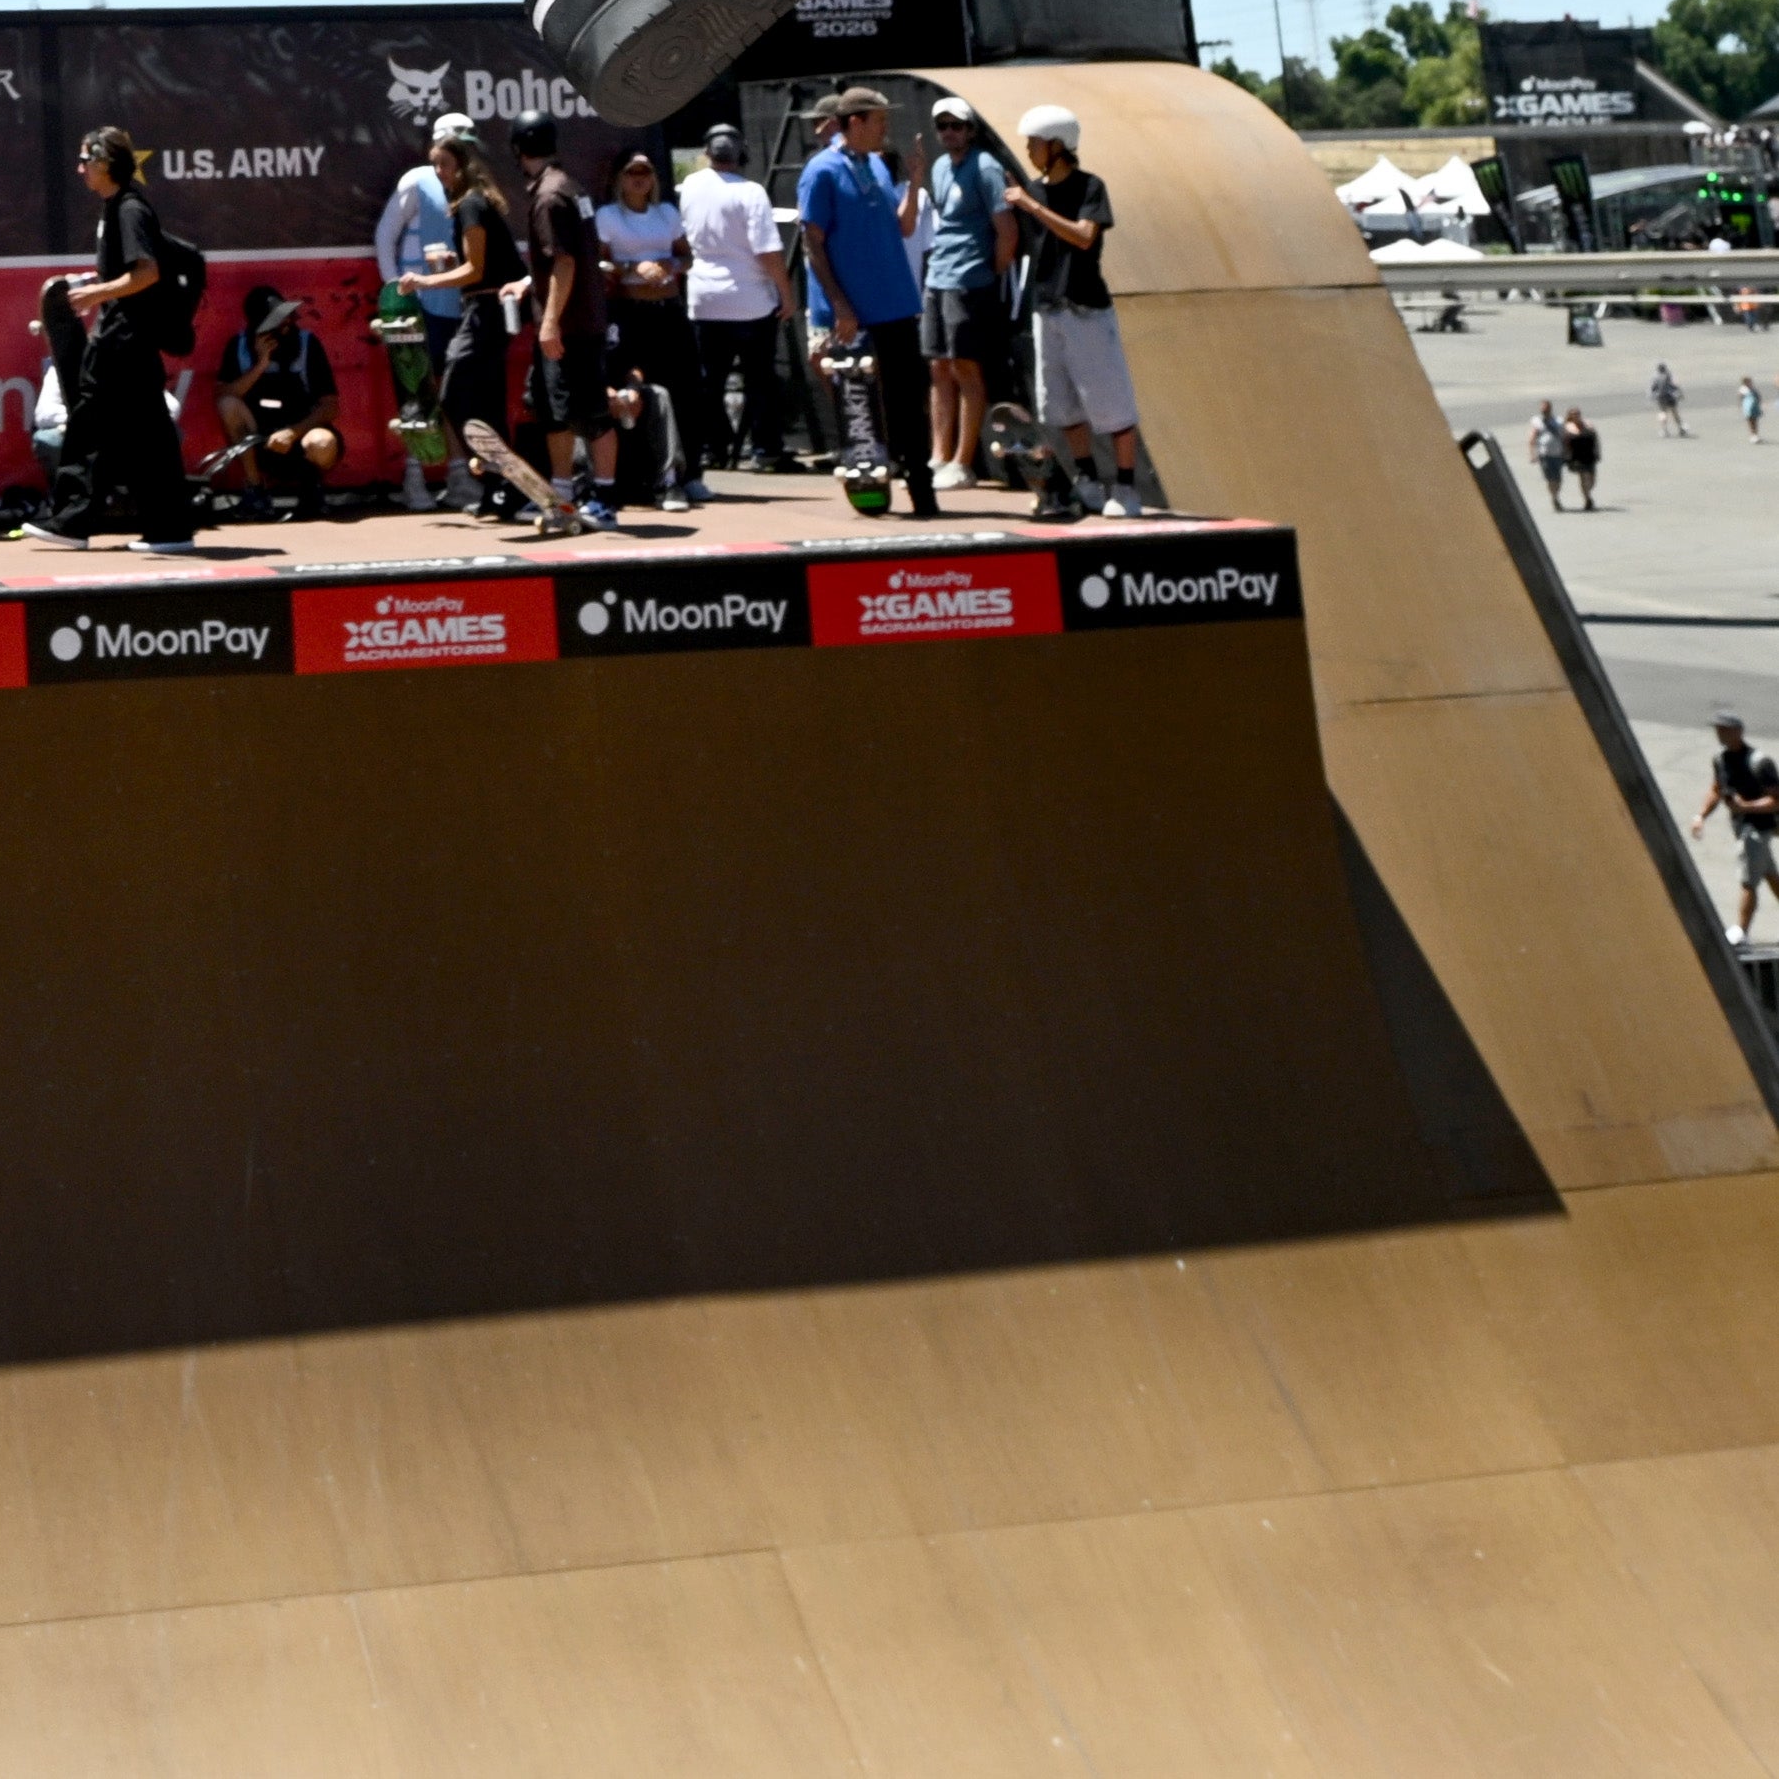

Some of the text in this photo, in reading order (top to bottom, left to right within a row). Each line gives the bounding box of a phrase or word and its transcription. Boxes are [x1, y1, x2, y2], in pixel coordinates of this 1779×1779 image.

[812, 21, 879, 38] 2026
[162, 145, 326, 180] U.S. ARMY
[395, 596, 464, 613] MoonPay
[1123, 564, 1279, 607] MoonPay
[623, 591, 788, 635] MoonPay
[96, 616, 270, 662] MoonPay
